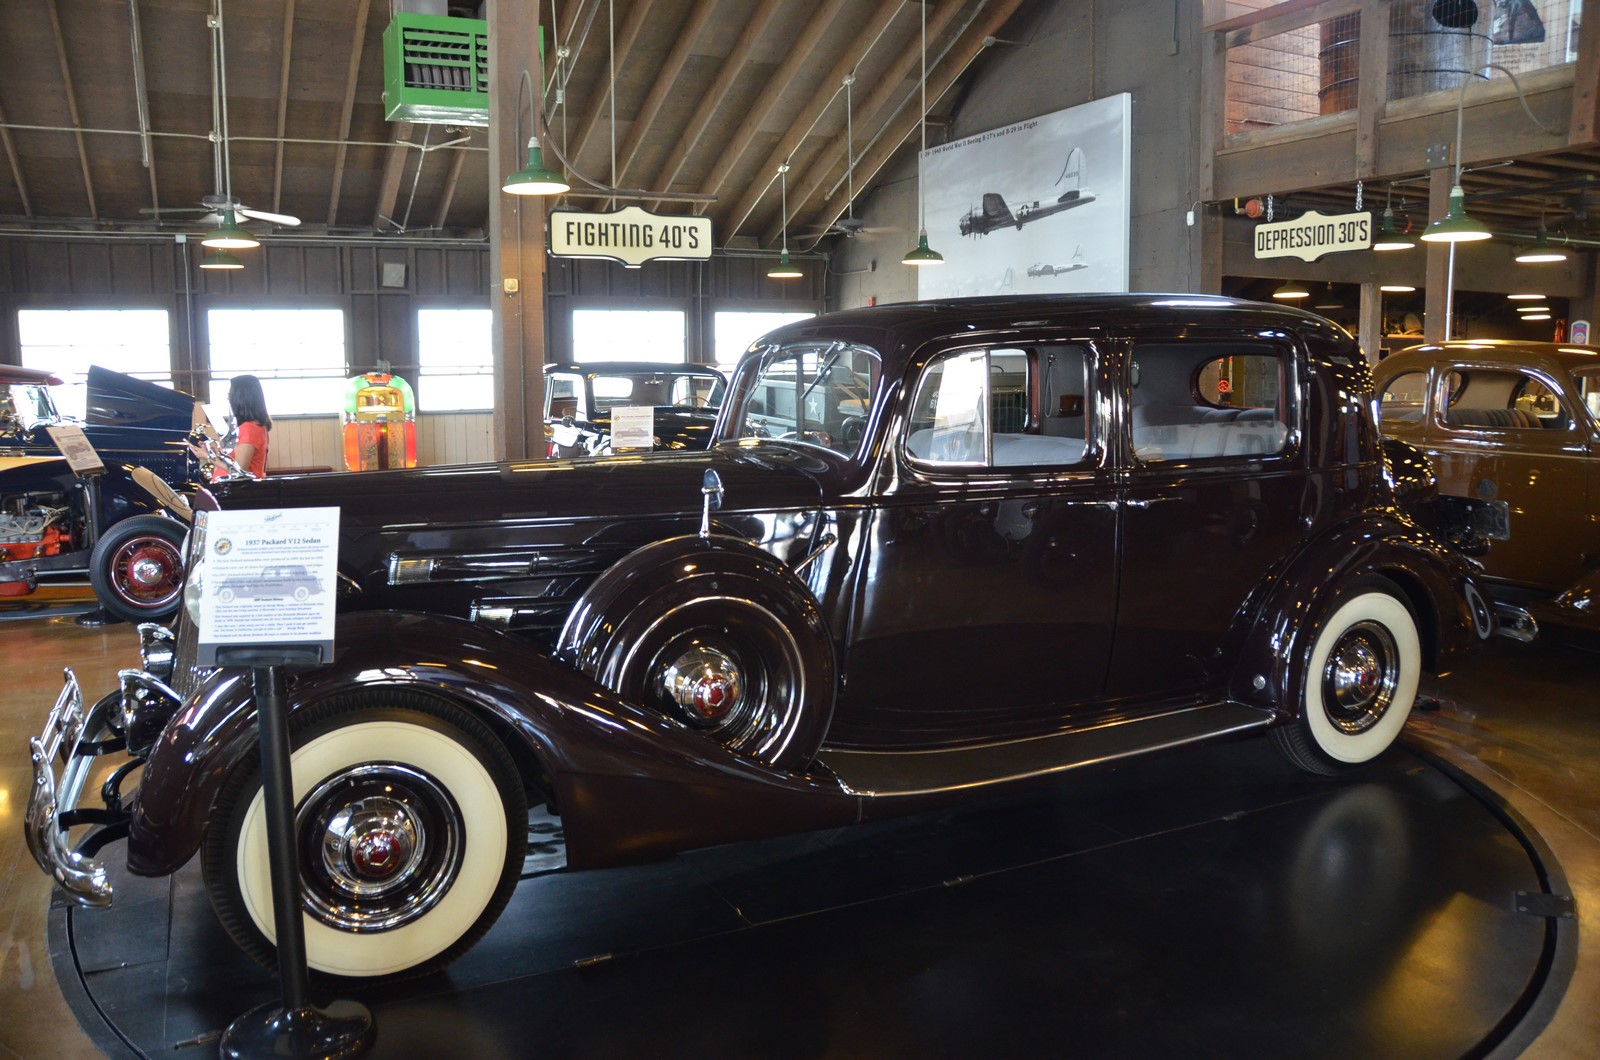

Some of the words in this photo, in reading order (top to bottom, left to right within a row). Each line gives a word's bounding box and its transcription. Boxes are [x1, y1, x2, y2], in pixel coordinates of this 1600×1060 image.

[967, 137, 982, 145] Boeing
[1005, 127, 1017, 136] B-29
[1023, 120, 1038, 130] Flight
[566, 221, 653, 248] FIGHTING
[659, 225, 699, 249] 40'S
[1257, 223, 1335, 252] DEPRESSION
[1338, 220, 1368, 243] 30'S
